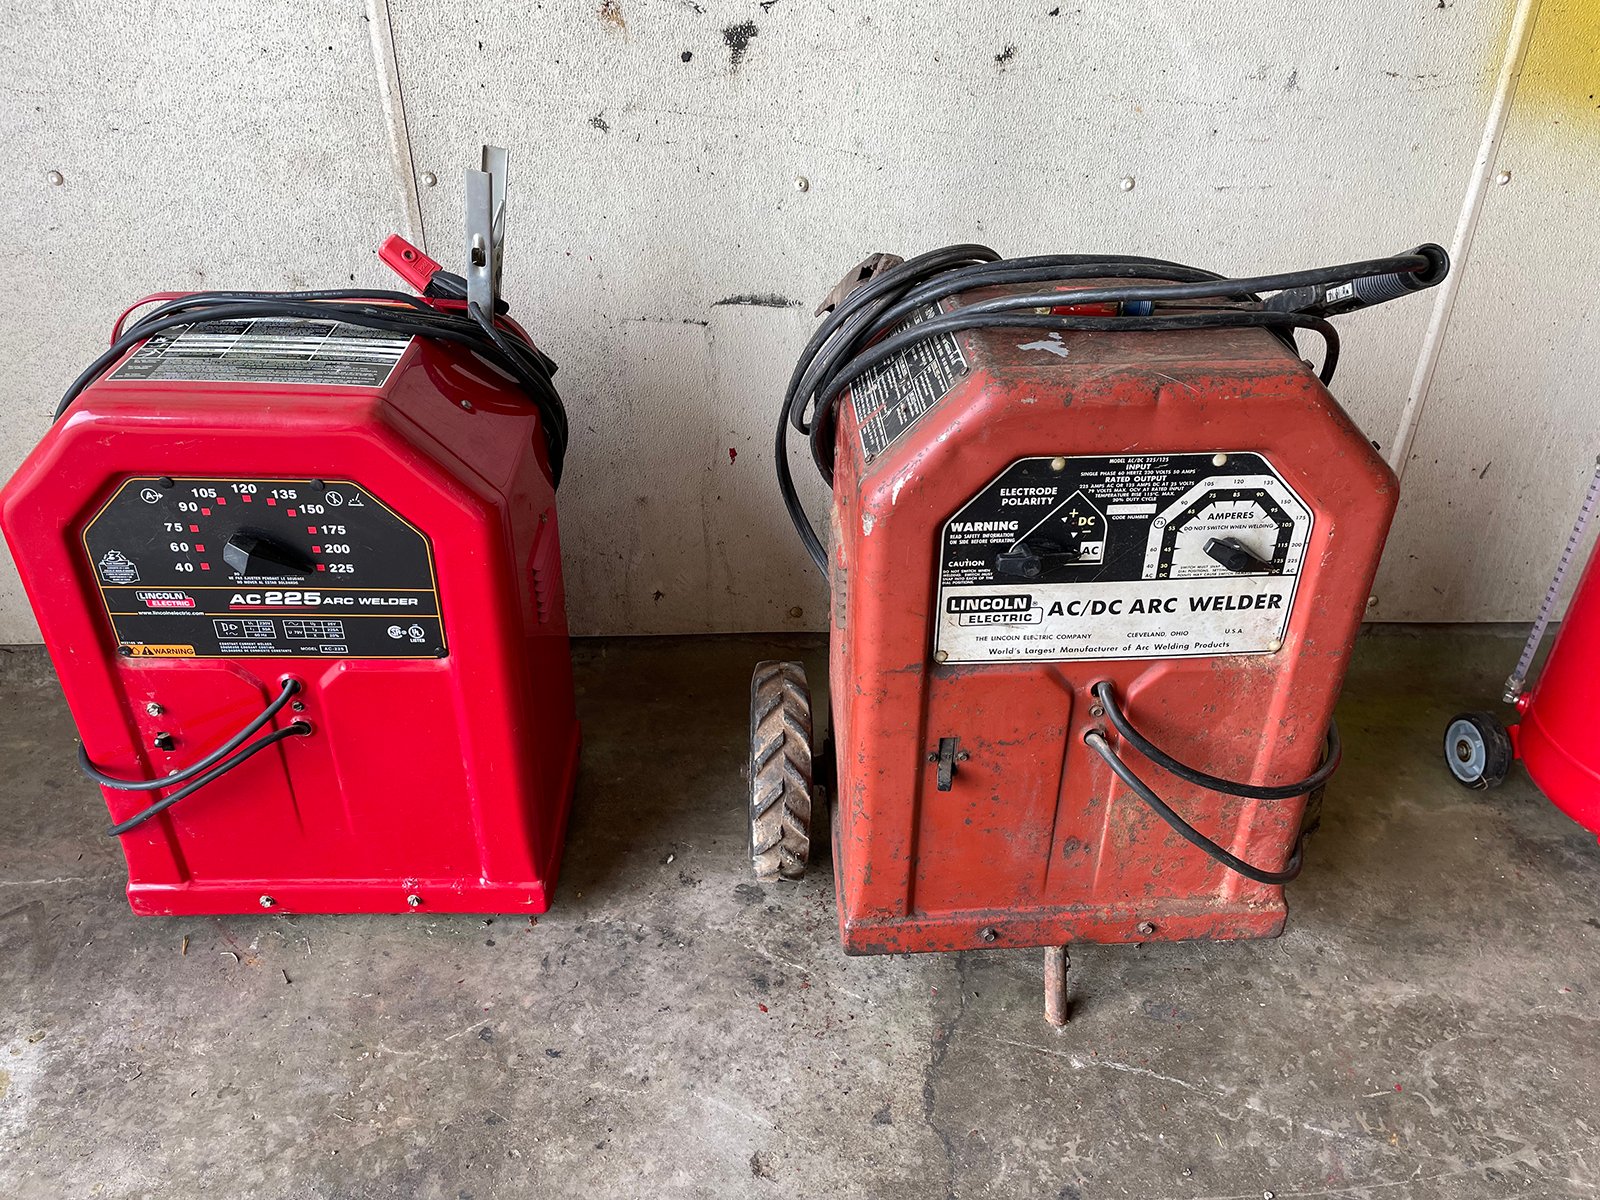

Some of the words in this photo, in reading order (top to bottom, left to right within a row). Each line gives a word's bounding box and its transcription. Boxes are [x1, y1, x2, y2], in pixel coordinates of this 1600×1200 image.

[191, 488, 217, 498] 105
[231, 484, 257, 494] 120
[271, 490, 297, 500] 135
[1000, 487, 1058, 496] ELECTRODE
[1002, 497, 1054, 506] POLARITY
[178, 502, 198, 512] 90
[299, 505, 324, 514] 150
[1207, 511, 1254, 520] AMPERES
[951, 520, 1018, 532] WARNING
[1078, 517, 1095, 526] DC
[164, 523, 183, 532] 75
[321, 525, 346, 535] 175
[170, 542, 189, 552] 60
[325, 544, 350, 554] 200
[1081, 546, 1099, 555] AC
[175, 563, 193, 572] 40
[329, 564, 354, 573] 225
[951, 598, 1027, 611] LINCOLN
[1048, 599, 1122, 616] AC/DC
[1128, 598, 1178, 614] ARC
[1189, 594, 1282, 612] WELDER
[969, 614, 1032, 623] ELECTRIC
[1025, 647, 1055, 655] Largest
[1154, 643, 1189, 651] Welding
